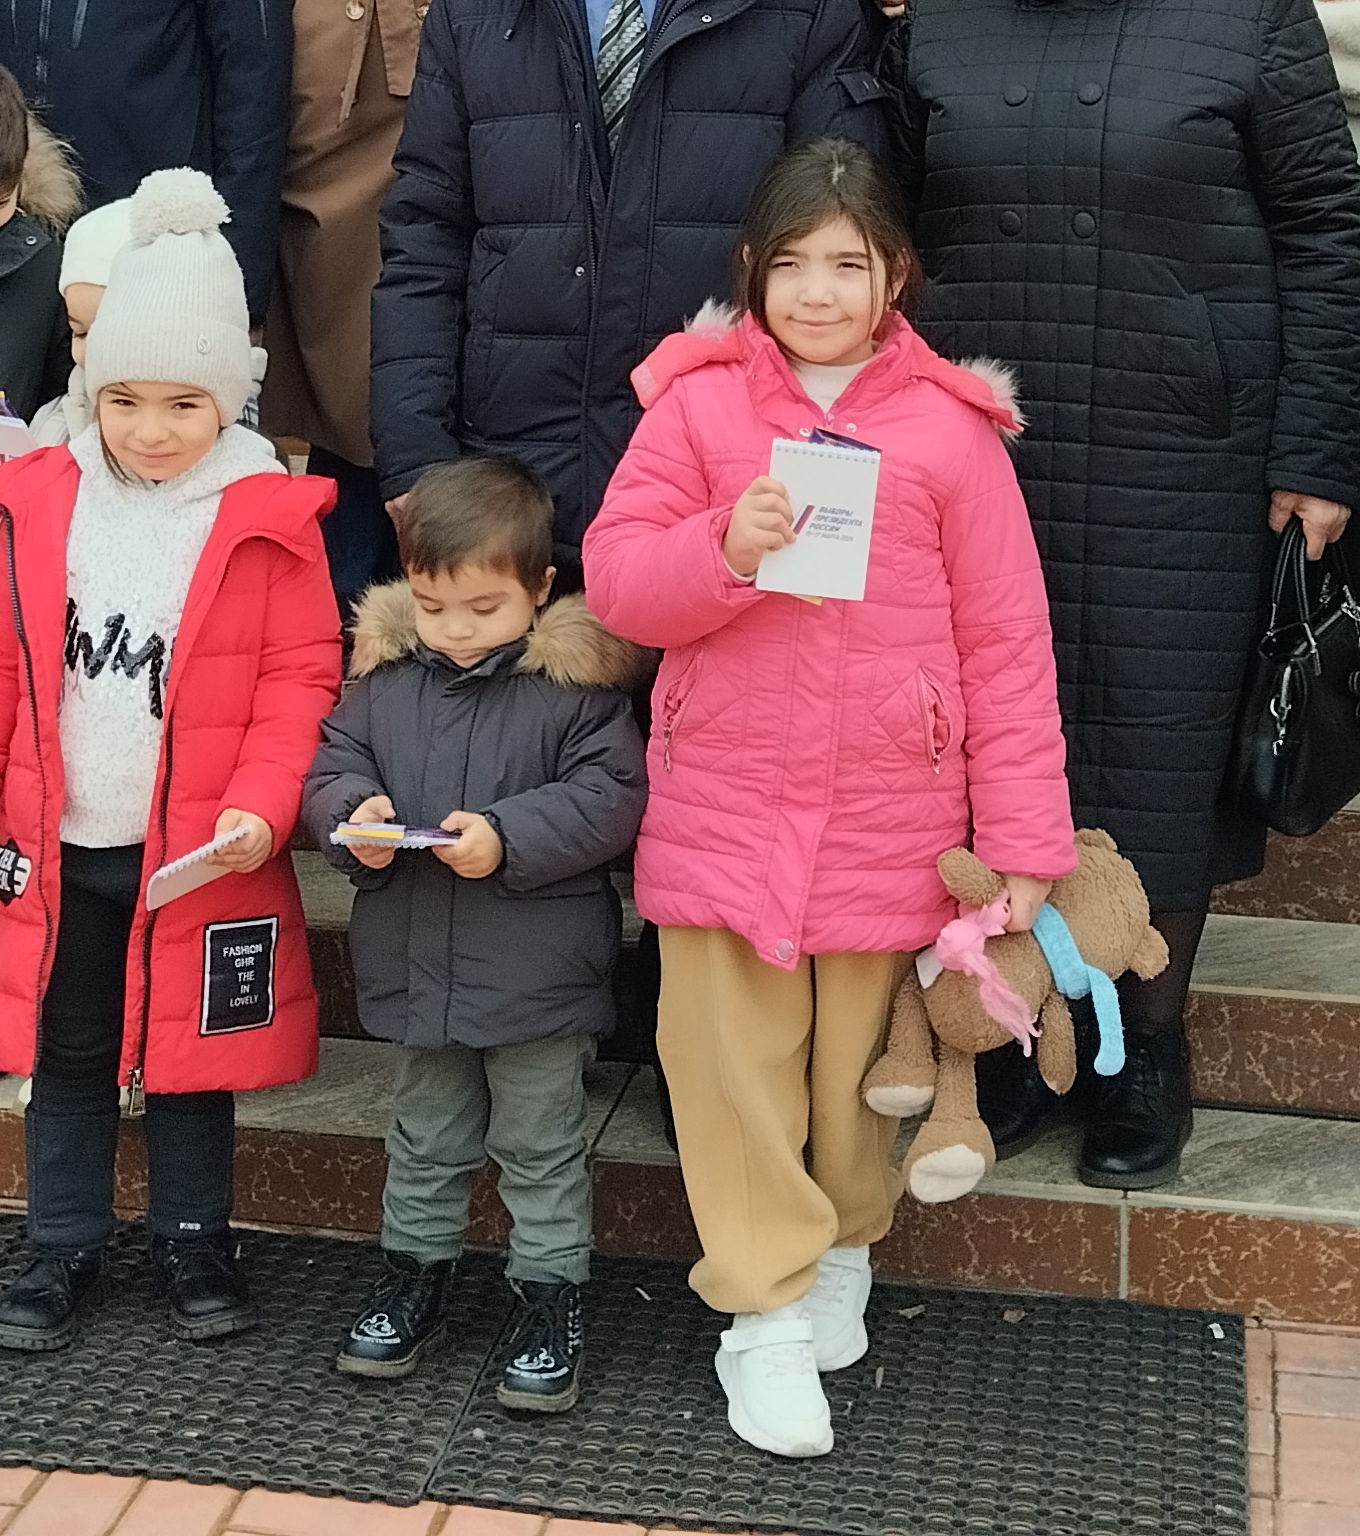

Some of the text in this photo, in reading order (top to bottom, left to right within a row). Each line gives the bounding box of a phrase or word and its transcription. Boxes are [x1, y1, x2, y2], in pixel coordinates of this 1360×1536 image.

[222, 943, 263, 958] FASHION
[237, 970, 256, 983] THE
[240, 984, 250, 995] IN
[229, 994, 259, 1008] LOVELY
